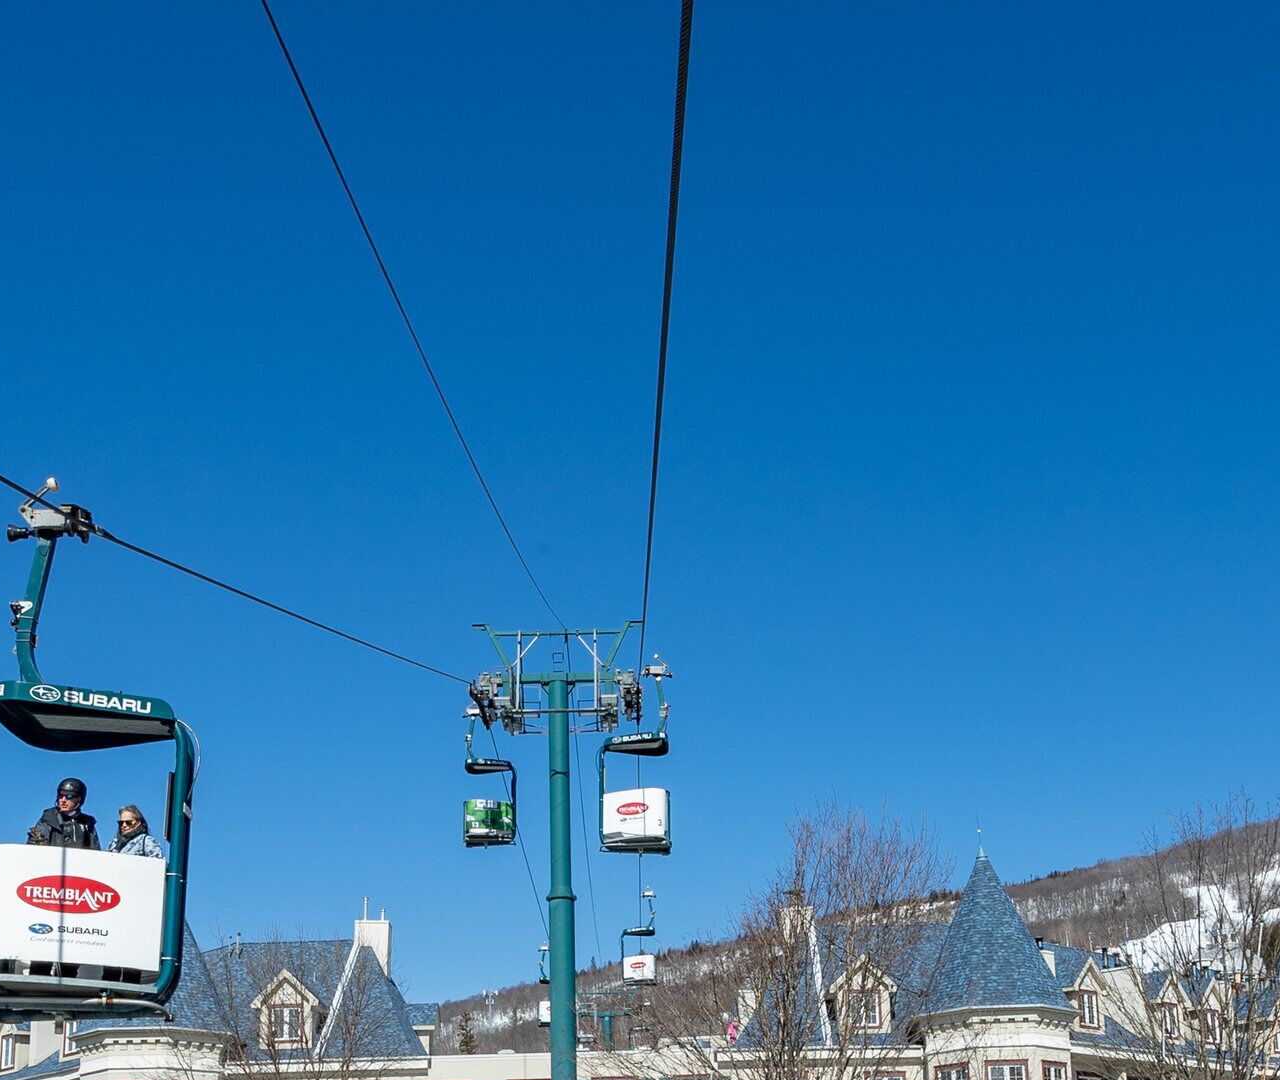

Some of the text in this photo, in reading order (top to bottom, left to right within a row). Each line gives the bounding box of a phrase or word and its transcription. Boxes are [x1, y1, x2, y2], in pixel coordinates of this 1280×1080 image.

[63, 690, 152, 714] SUBARU
[657, 818, 663, 827] 3
[24, 885, 115, 911] TREMBLANT
[57, 925, 109, 937] SUBARU
